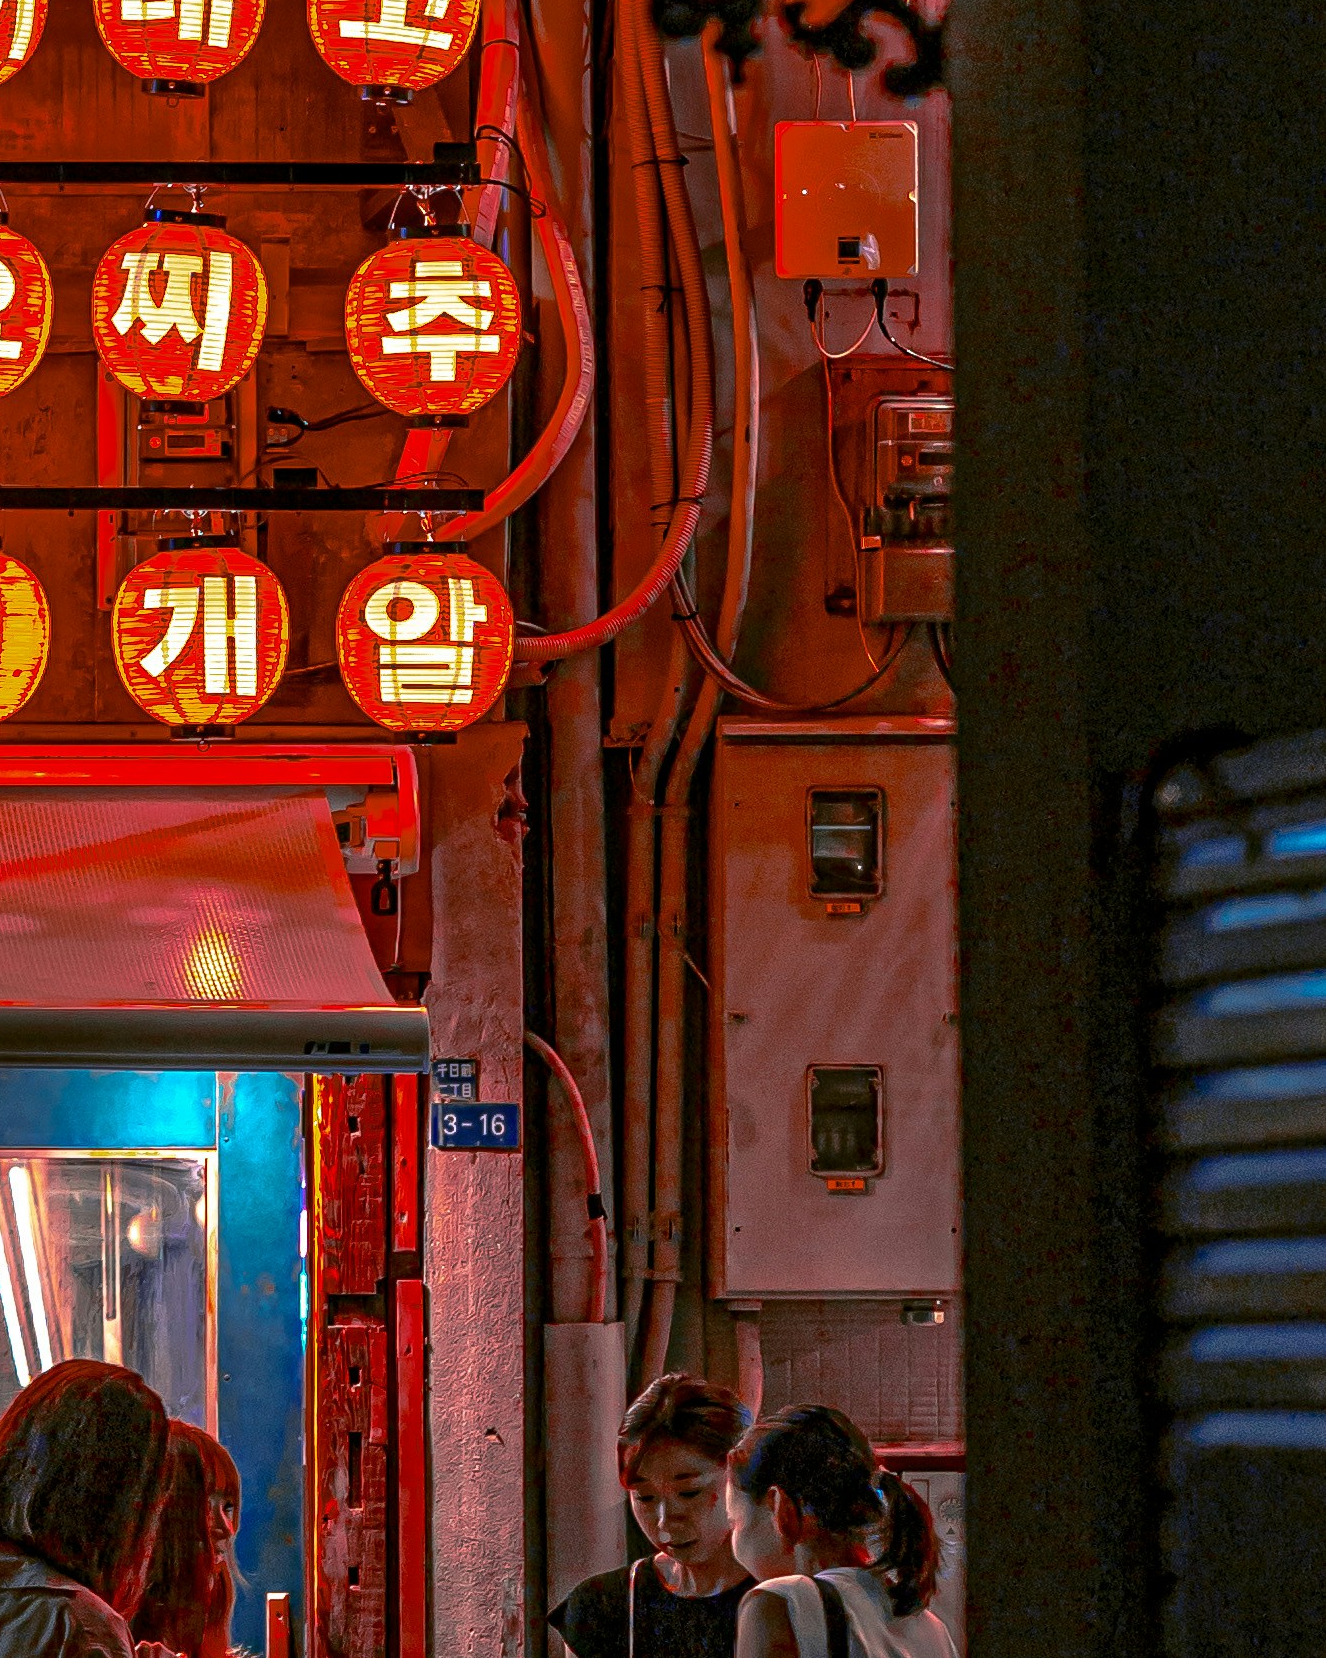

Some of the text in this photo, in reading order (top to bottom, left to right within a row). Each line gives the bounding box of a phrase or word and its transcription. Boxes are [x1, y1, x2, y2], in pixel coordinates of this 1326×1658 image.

[112, 252, 232, 371] 찌
[382, 262, 499, 381] 추
[140, 576, 256, 696] 개
[365, 579, 486, 703] 알
[439, 1083, 472, 1098] 二丁目
